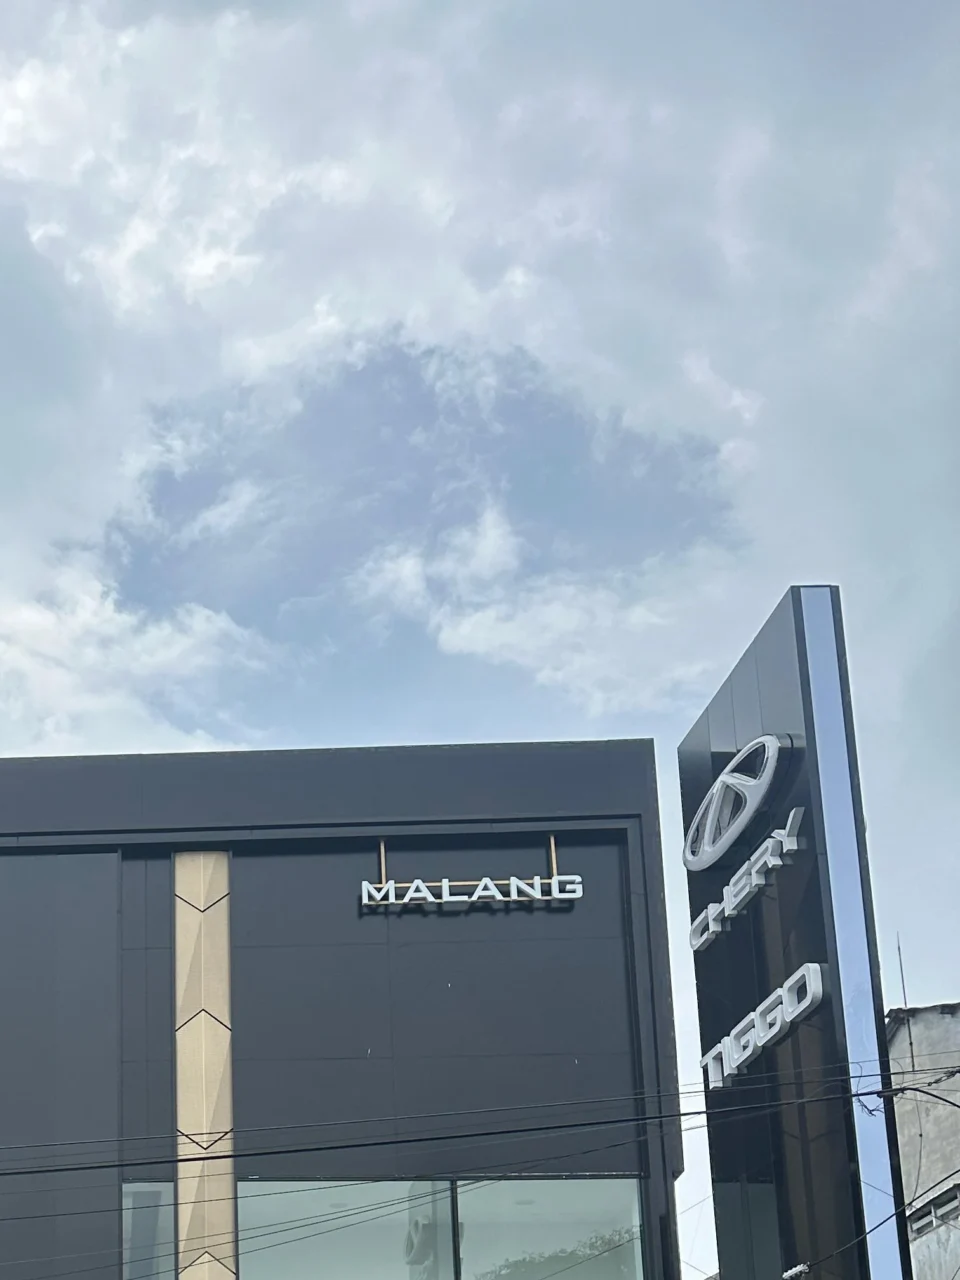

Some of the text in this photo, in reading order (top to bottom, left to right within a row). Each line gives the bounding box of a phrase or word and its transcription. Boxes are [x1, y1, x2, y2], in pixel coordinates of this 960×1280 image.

[361, 875, 583, 905] MALANG
[690, 807, 805, 951] CHERY
[700, 963, 823, 1089] TIGGO
